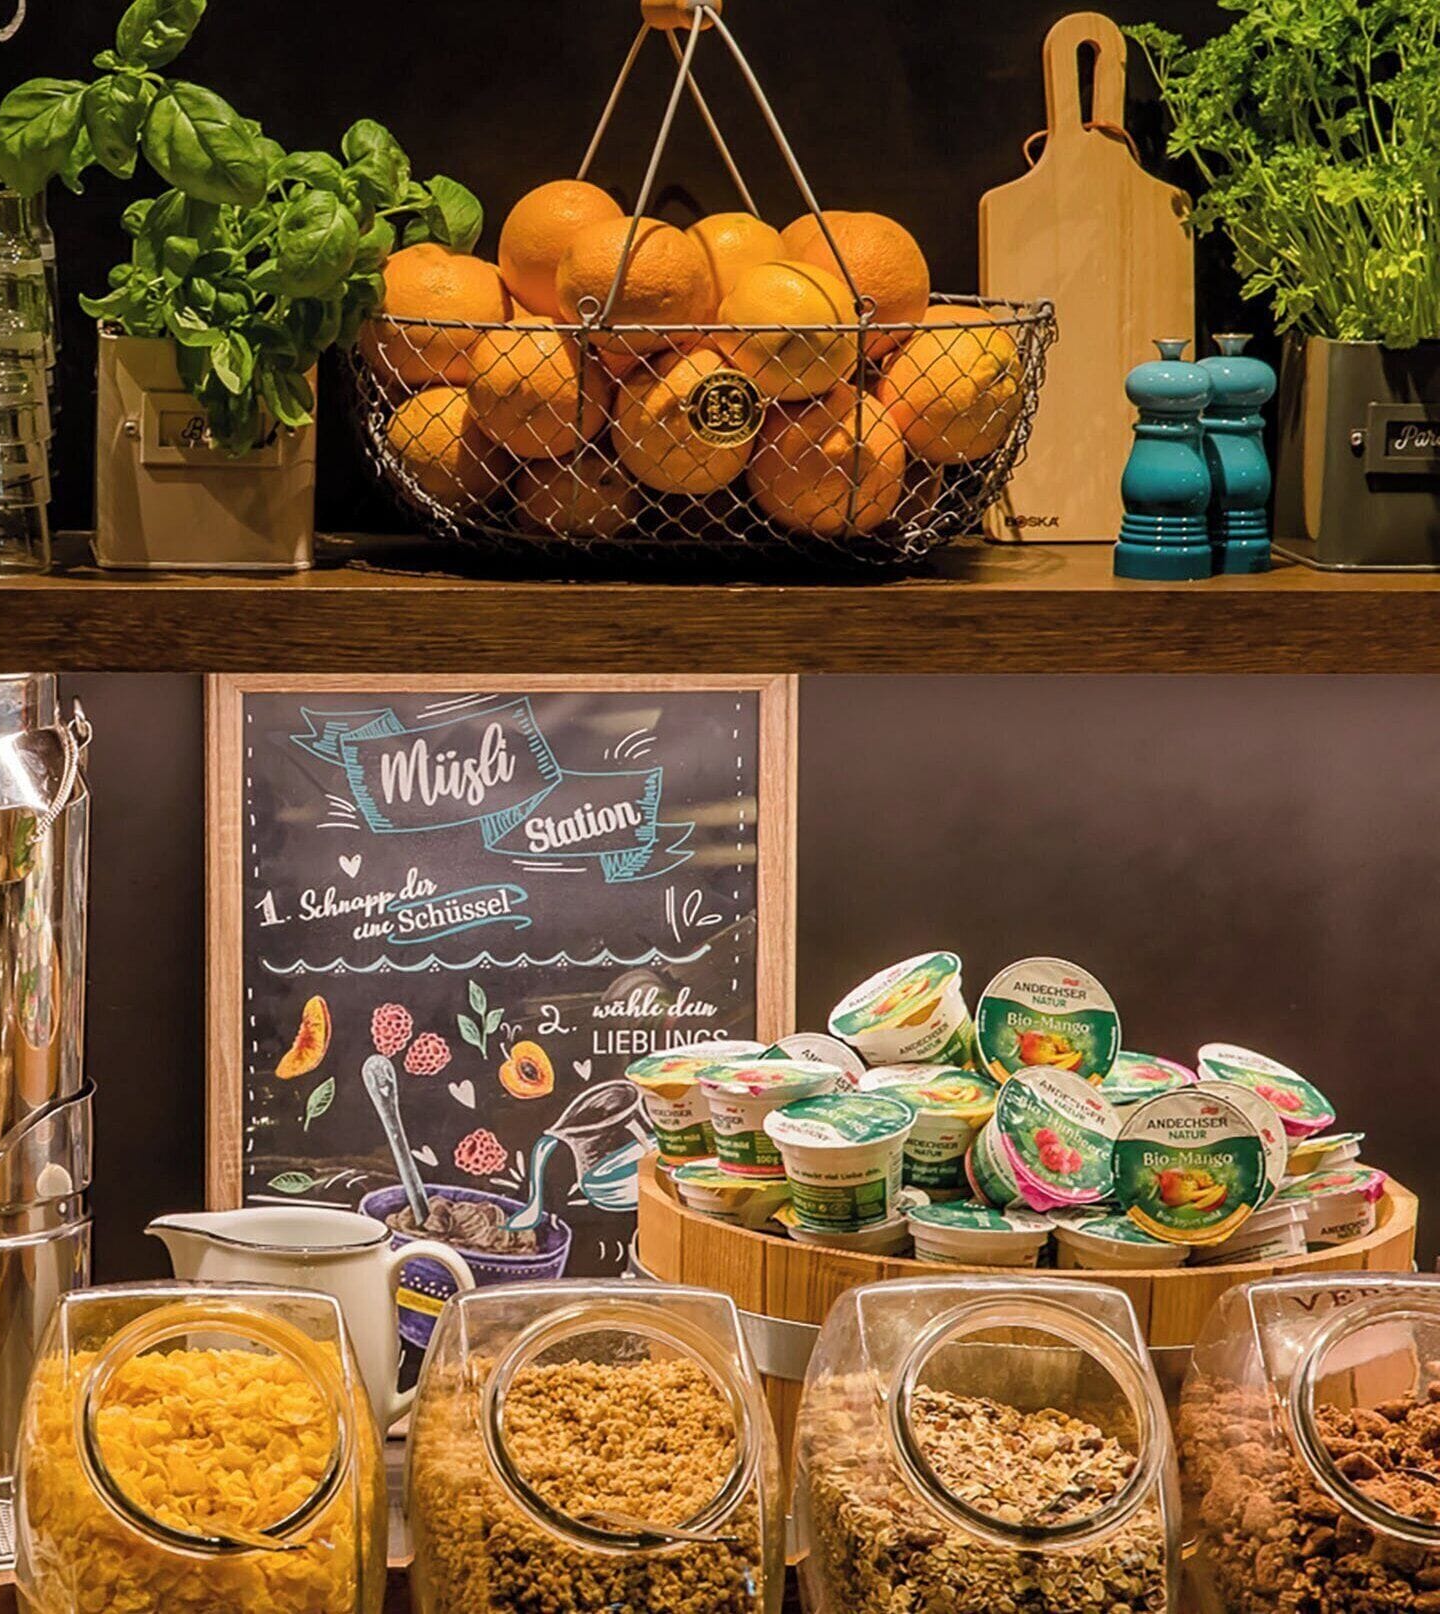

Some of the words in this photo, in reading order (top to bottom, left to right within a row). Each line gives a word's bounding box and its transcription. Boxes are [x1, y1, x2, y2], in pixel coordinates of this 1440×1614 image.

[1394, 424, 1440, 450] Par
[1004, 514, 1060, 529] BOSKA
[381, 722, 516, 806] Müsli
[525, 801, 641, 853] Station
[255, 890, 291, 926] 1.
[299, 886, 394, 920] Schnapp
[397, 888, 511, 934] Schüssel
[1013, 981, 1087, 1000] ANDECHSER
[1032, 995, 1066, 1008] NATUR
[538, 1004, 577, 1034] 2.
[592, 986, 663, 1018] wähle
[668, 987, 717, 1017] dein
[1007, 1012, 1090, 1037] Bio-Mango
[1039, 1080, 1106, 1126] ANDECHSER
[1147, 1117, 1228, 1130] ANDECHSER
[1168, 1130, 1207, 1140] NATUR
[1143, 1151, 1233, 1166] Bio-Mango
